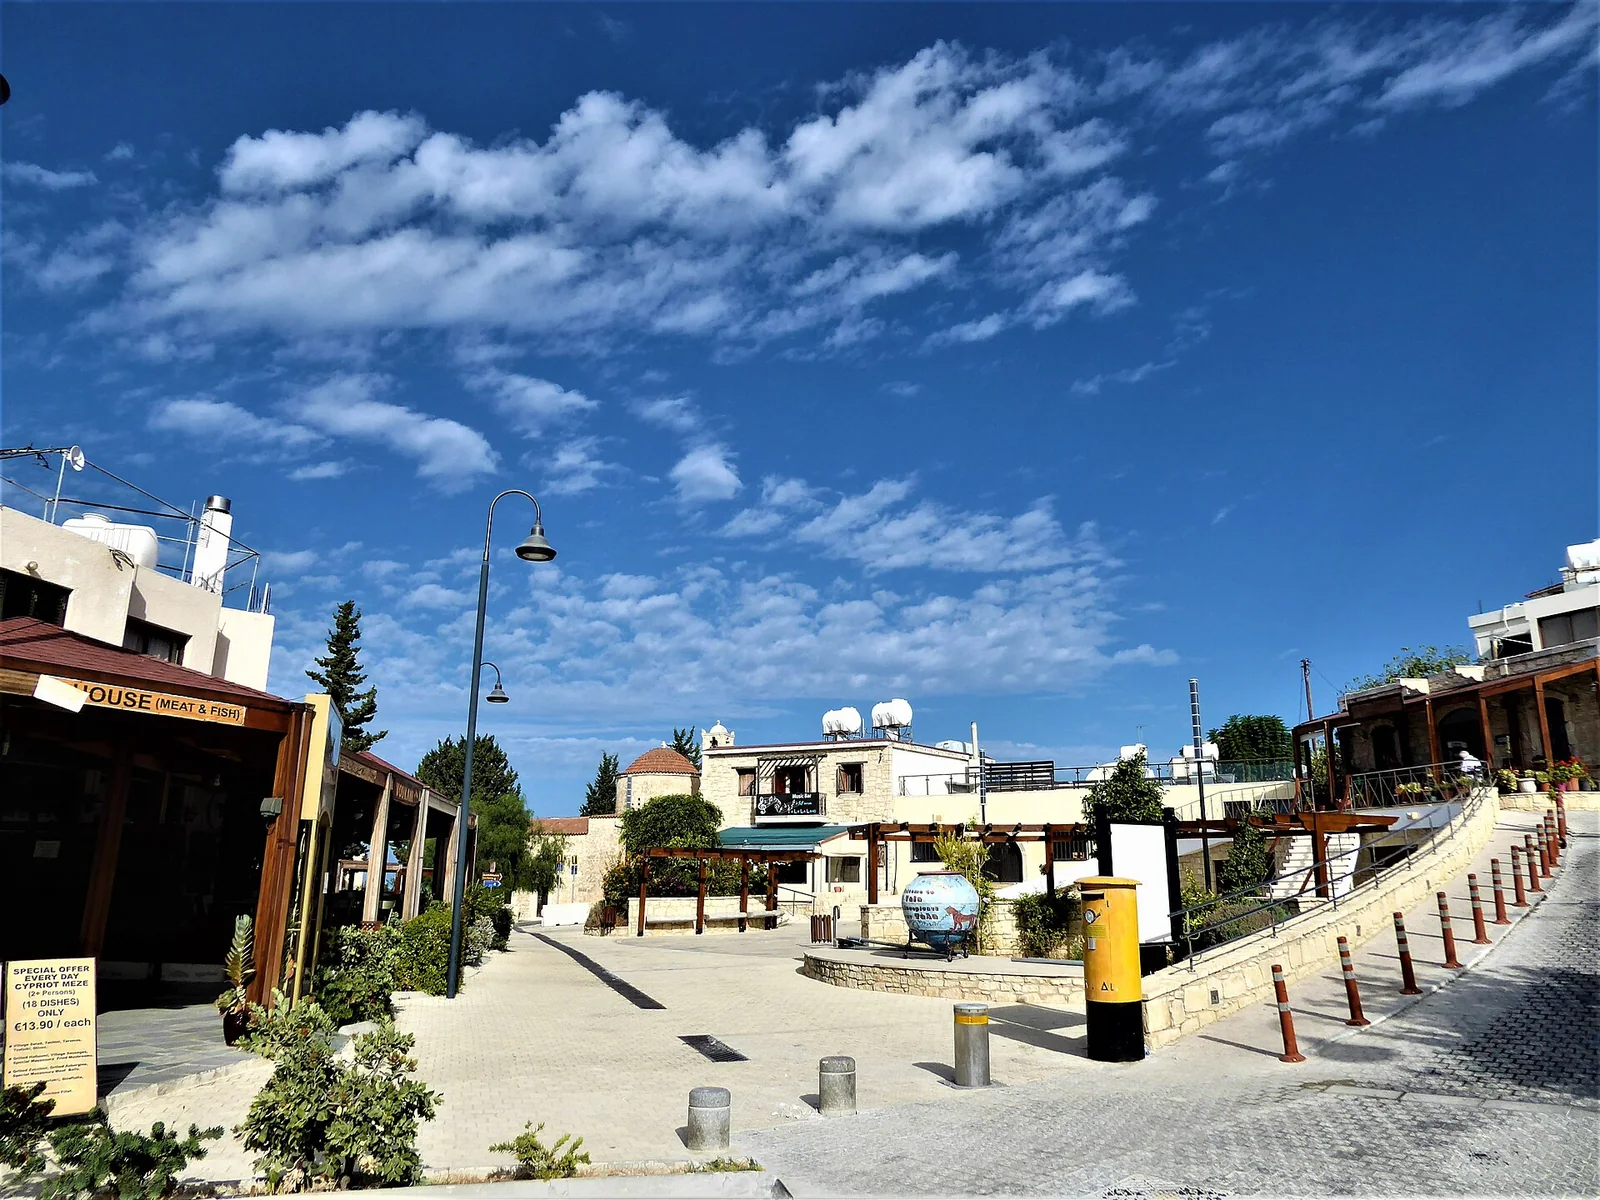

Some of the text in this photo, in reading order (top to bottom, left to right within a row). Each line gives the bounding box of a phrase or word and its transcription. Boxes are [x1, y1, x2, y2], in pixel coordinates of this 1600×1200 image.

[155, 698, 195, 713] (MEAT
[198, 703, 207, 714] &
[210, 706, 241, 721] FISH)
[13, 967, 56, 975] SPECIAL
[24, 974, 58, 982] EVERY
[14, 981, 59, 990] CYPRIOT
[22, 998, 80, 1010] (18 DISHES)
[37, 1009, 65, 1017] ONLY
[14, 1020, 54, 1032] €13.90
[63, 1018, 91, 1028] each
